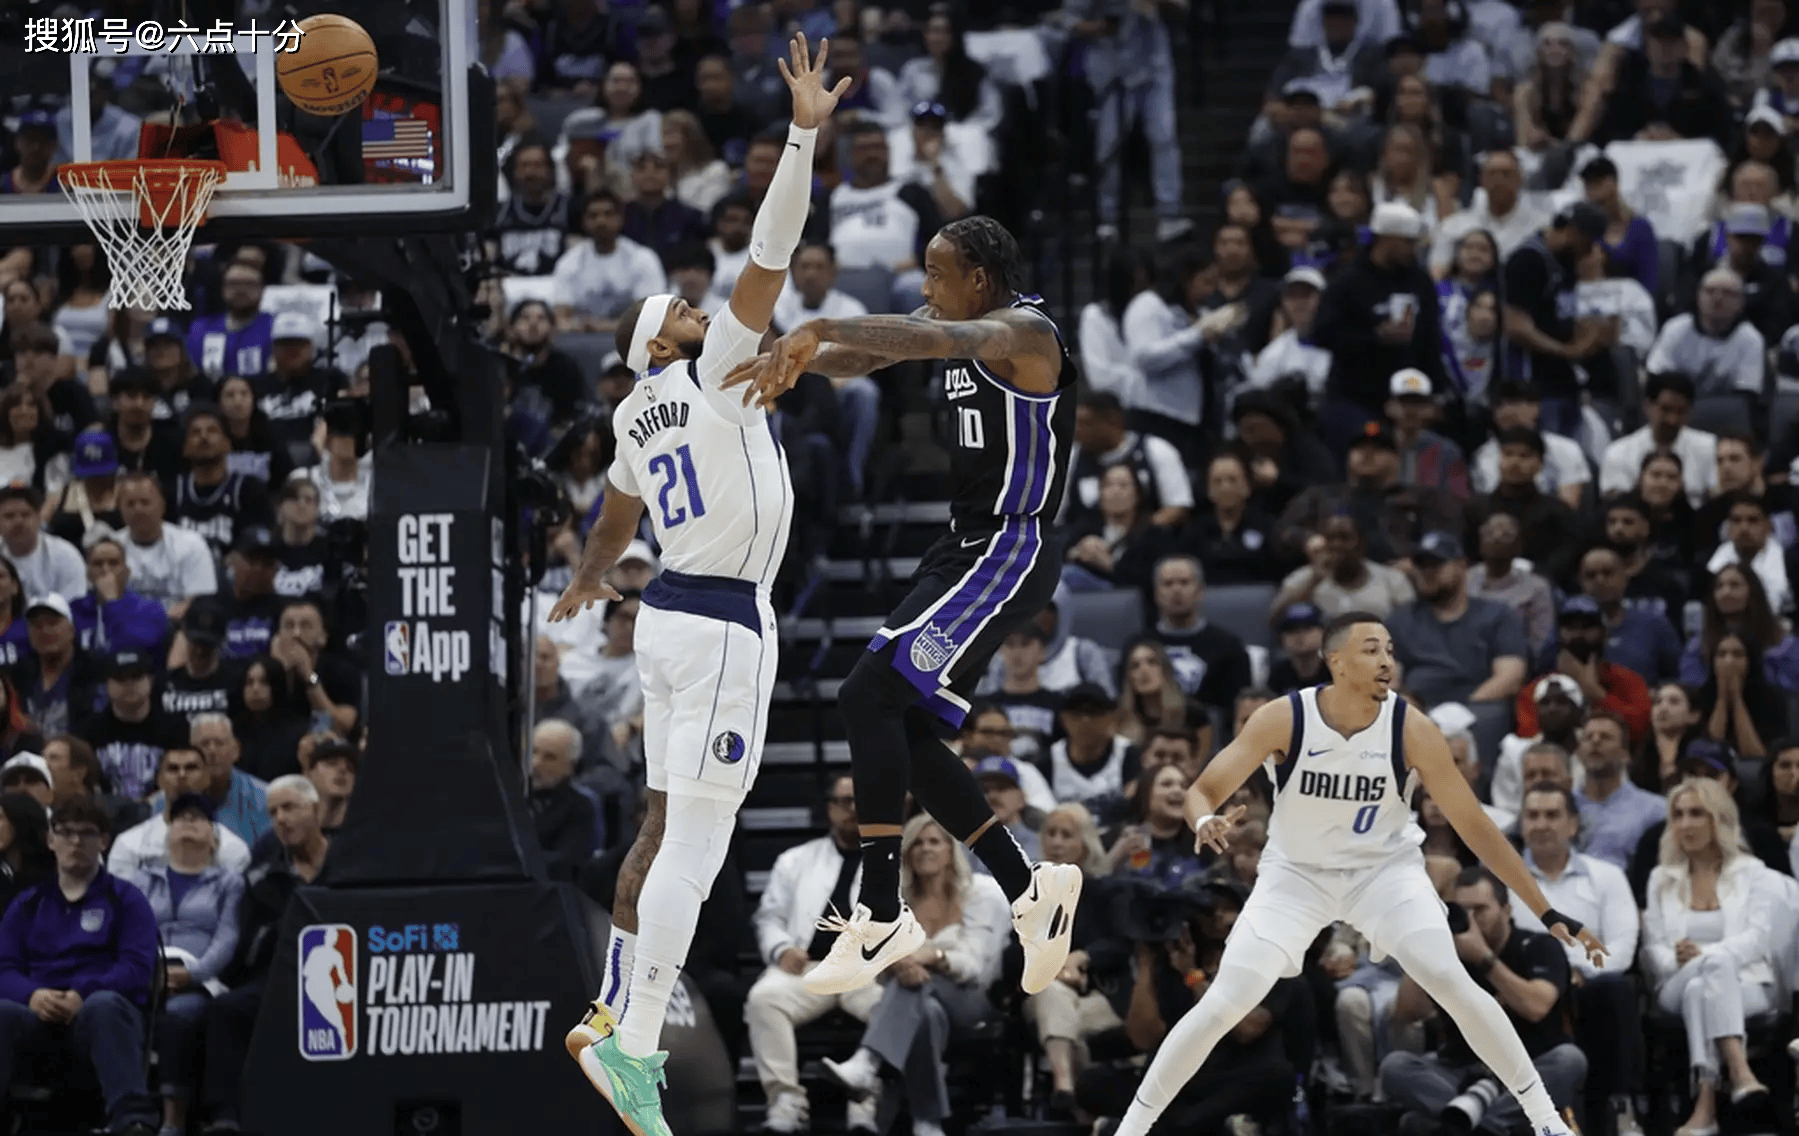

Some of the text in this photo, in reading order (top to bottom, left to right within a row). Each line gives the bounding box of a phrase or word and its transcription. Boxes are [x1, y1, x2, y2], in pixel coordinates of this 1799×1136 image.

[628, 401, 690, 448] GAFFORD
[957, 405, 985, 449] 10
[648, 443, 706, 529] 21
[398, 513, 455, 564] GET
[397, 566, 456, 617] THE
[412, 621, 470, 683] App
[1299, 769, 1387, 802] DALLAS
[1352, 804, 1381, 834] 0
[368, 925, 428, 952] SoFi
[366, 953, 475, 1005] PLAY-IN
[308, 1028, 337, 1051] NBA
[366, 1000, 551, 1056] TOURNAMENT
